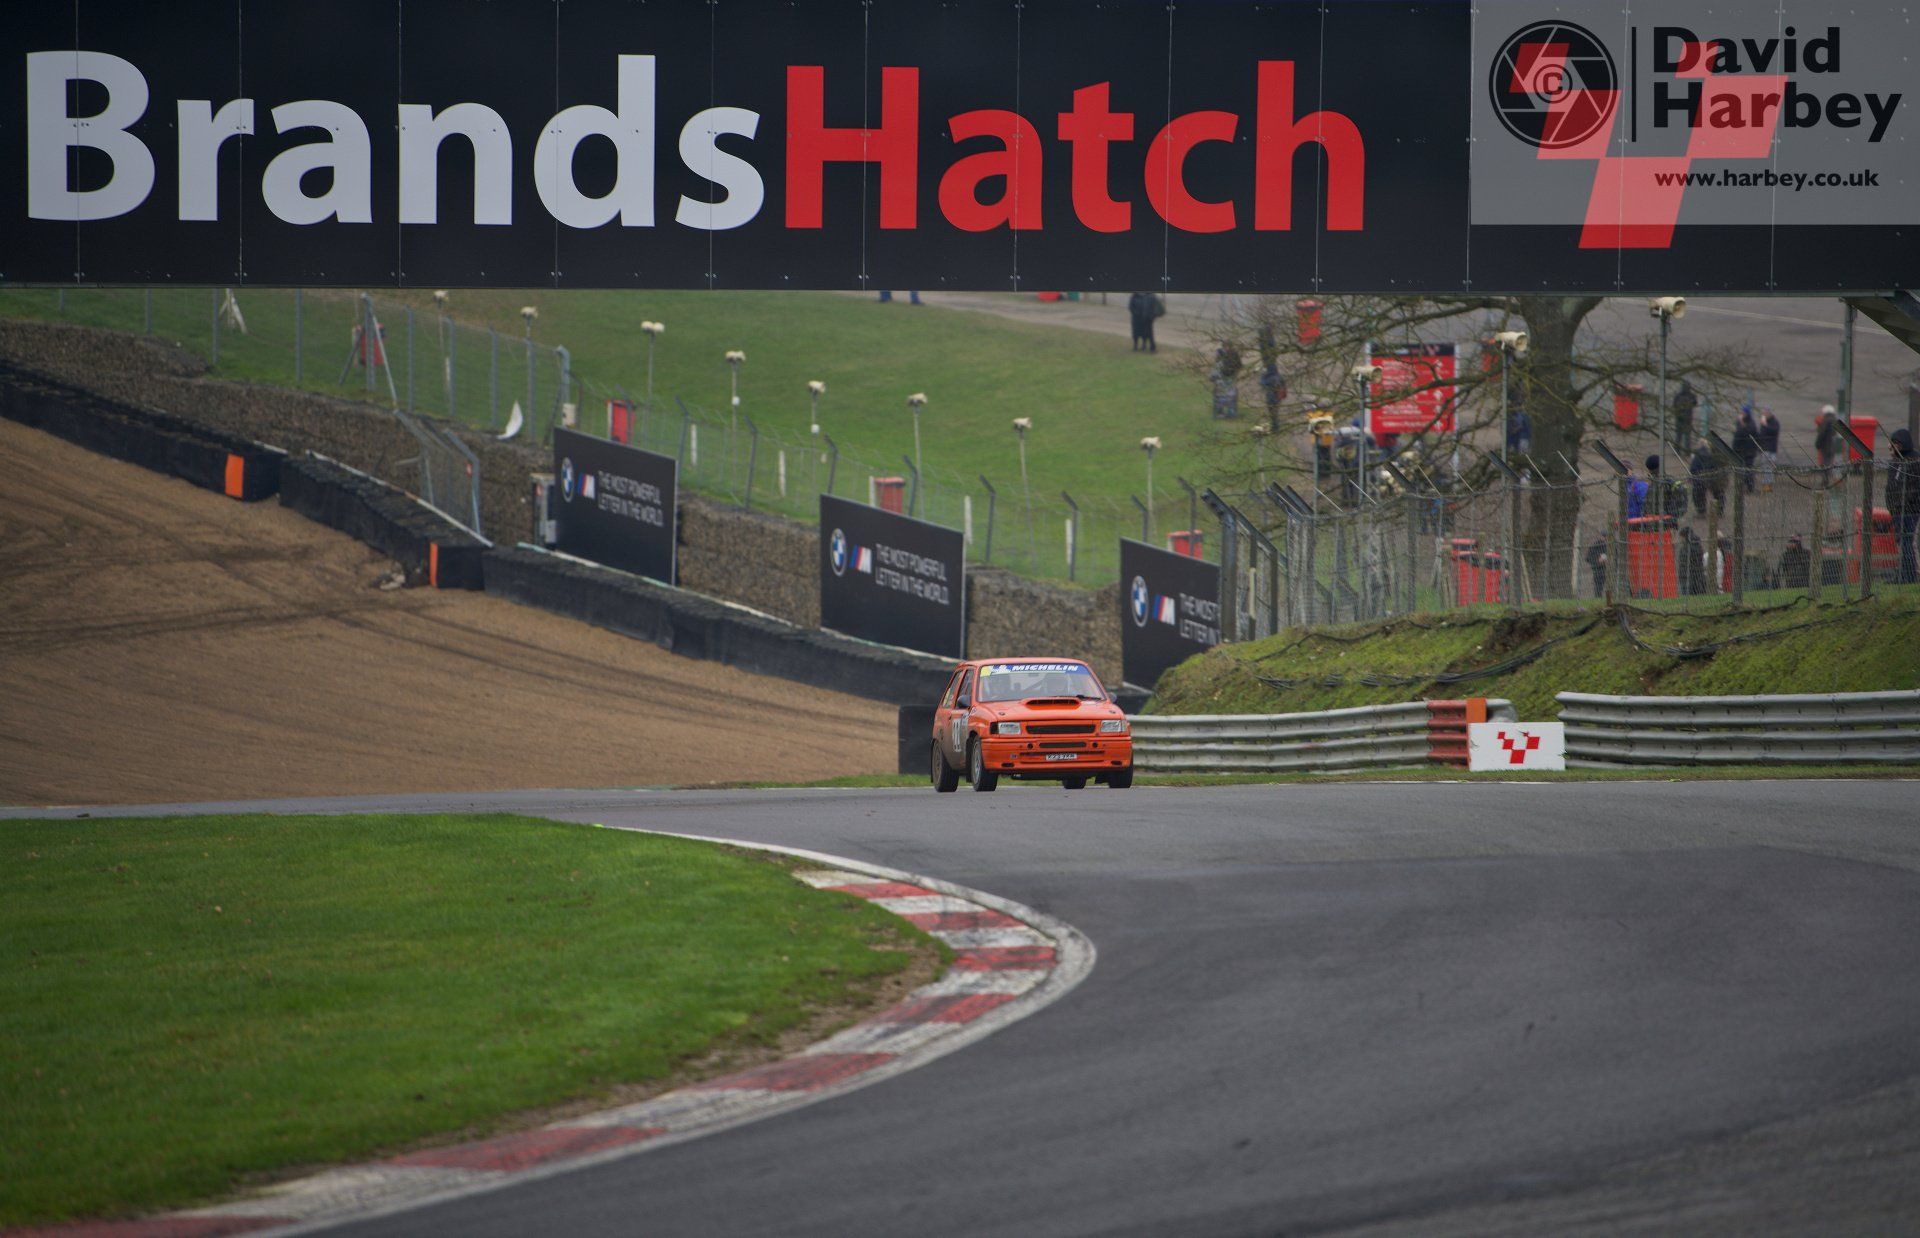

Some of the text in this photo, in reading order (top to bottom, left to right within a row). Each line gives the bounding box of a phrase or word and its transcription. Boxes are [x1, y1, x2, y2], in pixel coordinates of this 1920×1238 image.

[876, 543, 890, 565] THE
[890, 549, 910, 571] MOST
[876, 566, 901, 591] LETTER
[1180, 592, 1195, 616] THE
[1180, 618, 1208, 645] LETTER
[1011, 664, 1079, 672] MICHELIN
